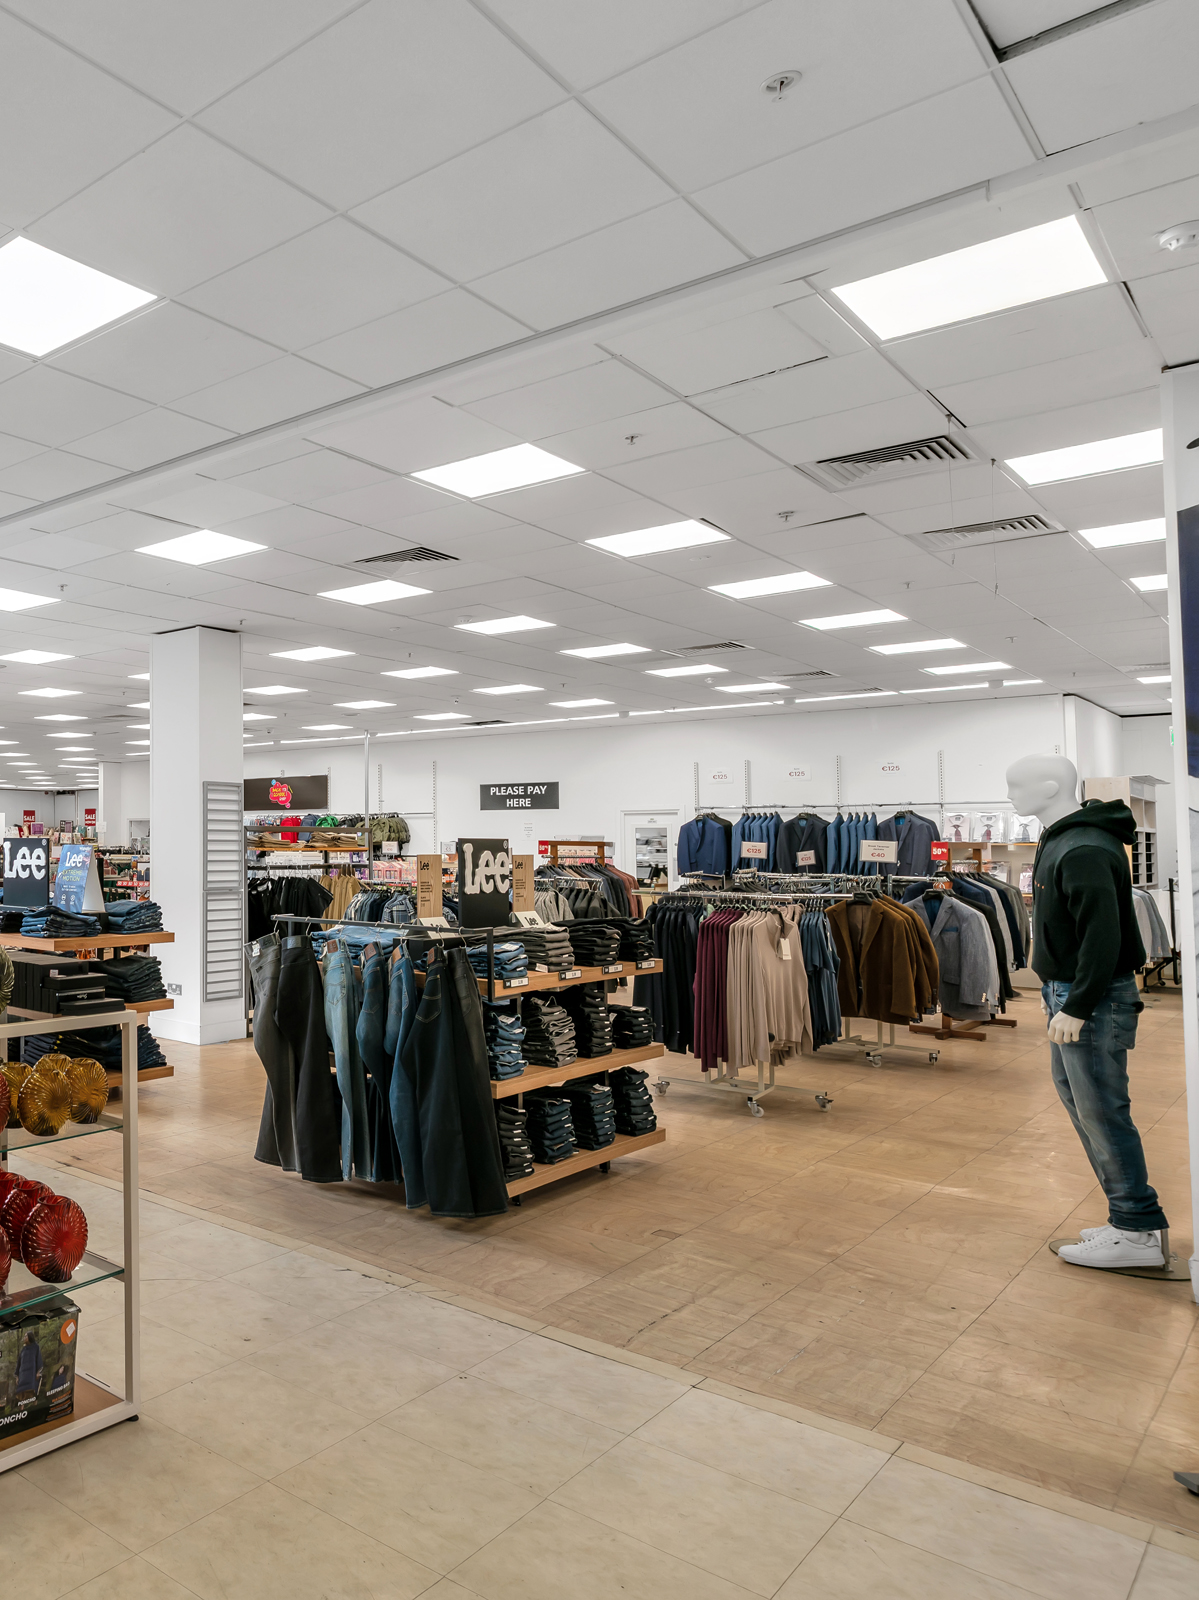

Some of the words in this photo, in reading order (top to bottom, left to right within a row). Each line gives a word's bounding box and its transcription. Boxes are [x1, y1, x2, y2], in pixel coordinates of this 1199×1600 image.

[490, 786, 525, 796] PLEASE
[527, 785, 547, 795] PAY
[506, 798, 532, 807] HERE
[3, 841, 46, 880] Lee
[65, 851, 83, 867] Lee
[420, 860, 430, 871] Lee
[463, 843, 511, 895] Lee
[514, 860, 523, 870] Lee
[524, 916, 539, 926] Lee
[17, 1396, 37, 1406] PONCHO
